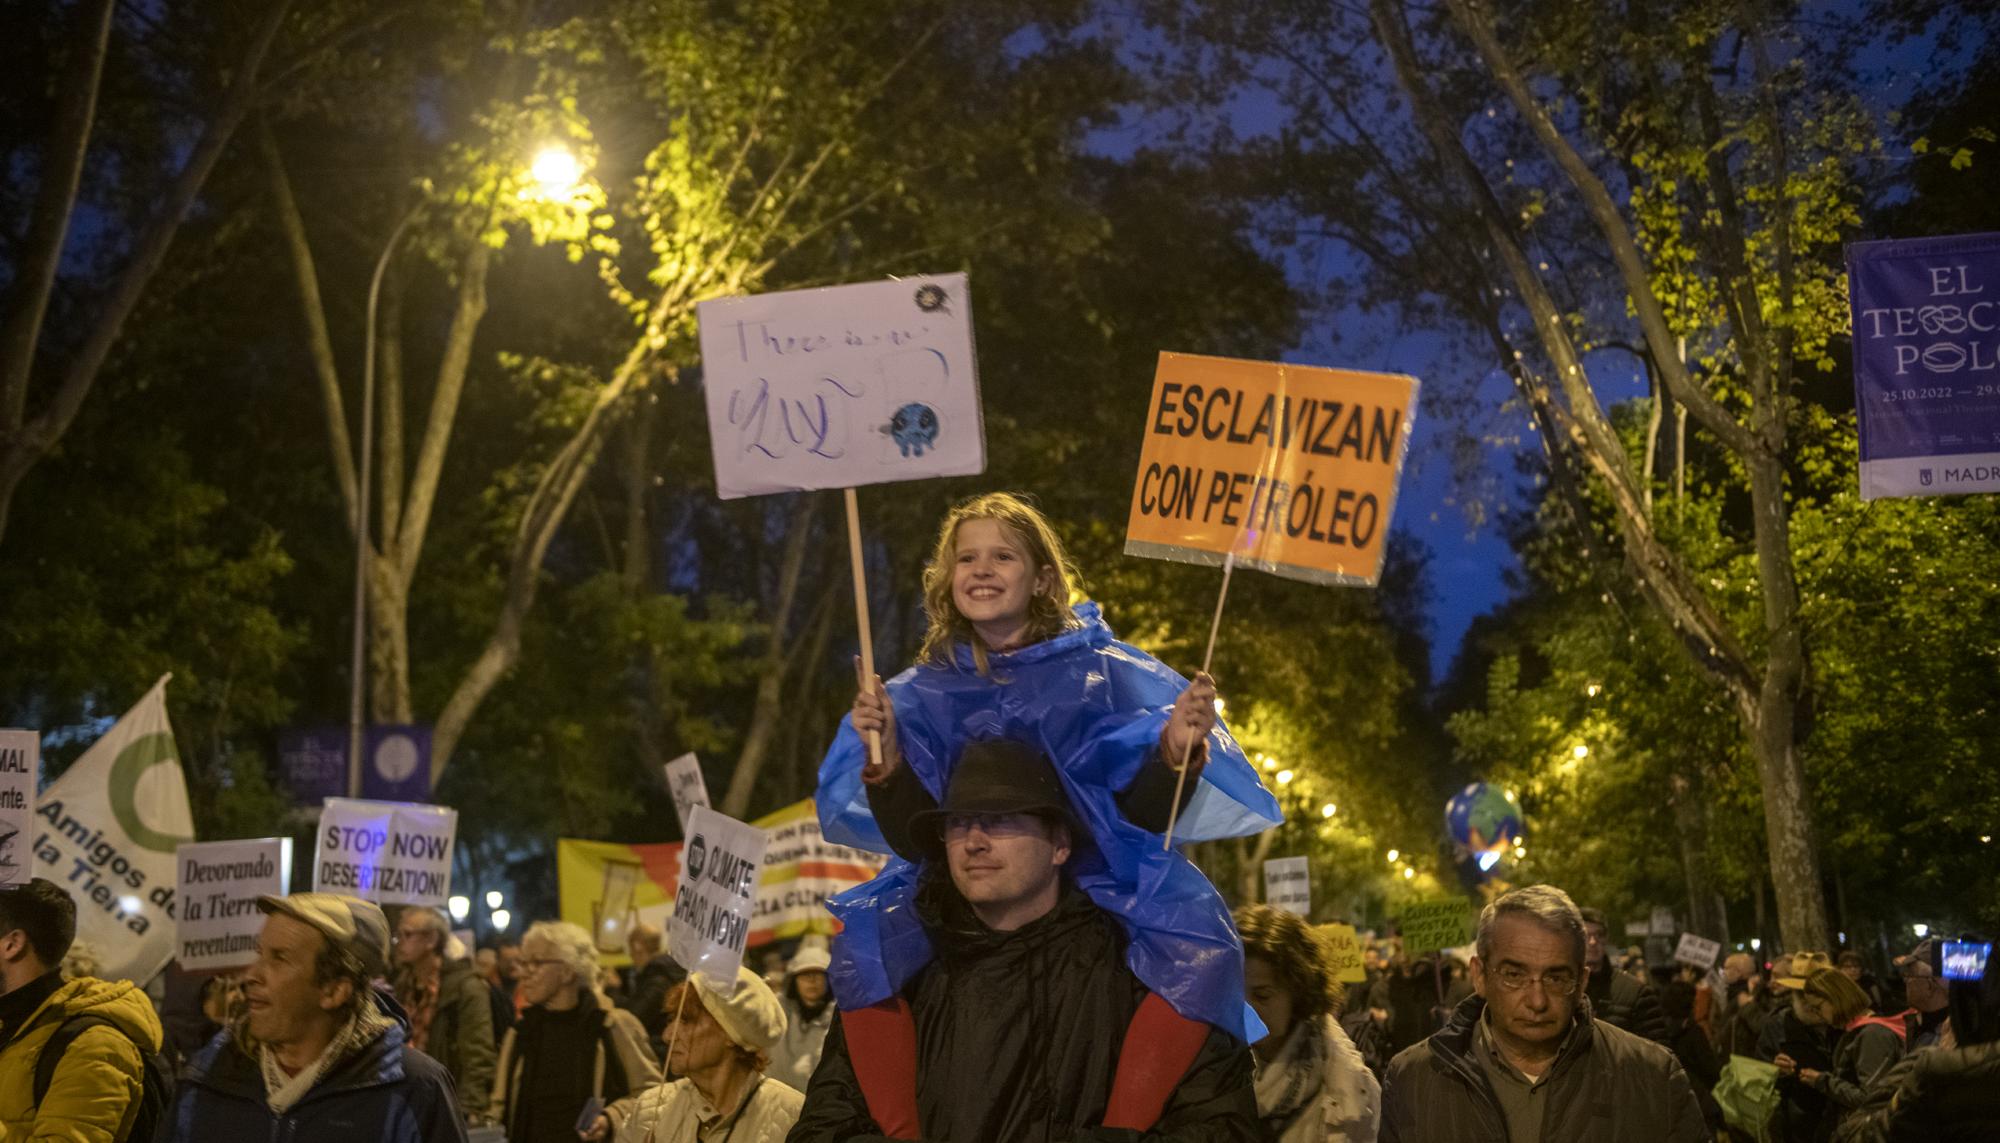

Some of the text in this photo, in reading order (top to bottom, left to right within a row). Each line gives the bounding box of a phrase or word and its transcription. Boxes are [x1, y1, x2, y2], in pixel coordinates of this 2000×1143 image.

[1928, 265, 1983, 297] EL
[1882, 387, 1952, 402] 25.10.2022
[1153, 381, 1402, 465] ESCLAVIZAN
[1139, 461, 1380, 550] CON PETRÓLEO
[0, 786, 27, 809] nte.
[32, 833, 62, 866] la
[36, 799, 147, 888] Amigos
[325, 825, 449, 861] STOP NOW
[184, 851, 275, 885] Devorando
[320, 861, 445, 897] DESERTIZATION!
[707, 845, 755, 900] CLIMATE
[183, 895, 201, 922] la
[706, 903, 749, 955] NOW!
[1407, 928, 1467, 950] TIERRA
